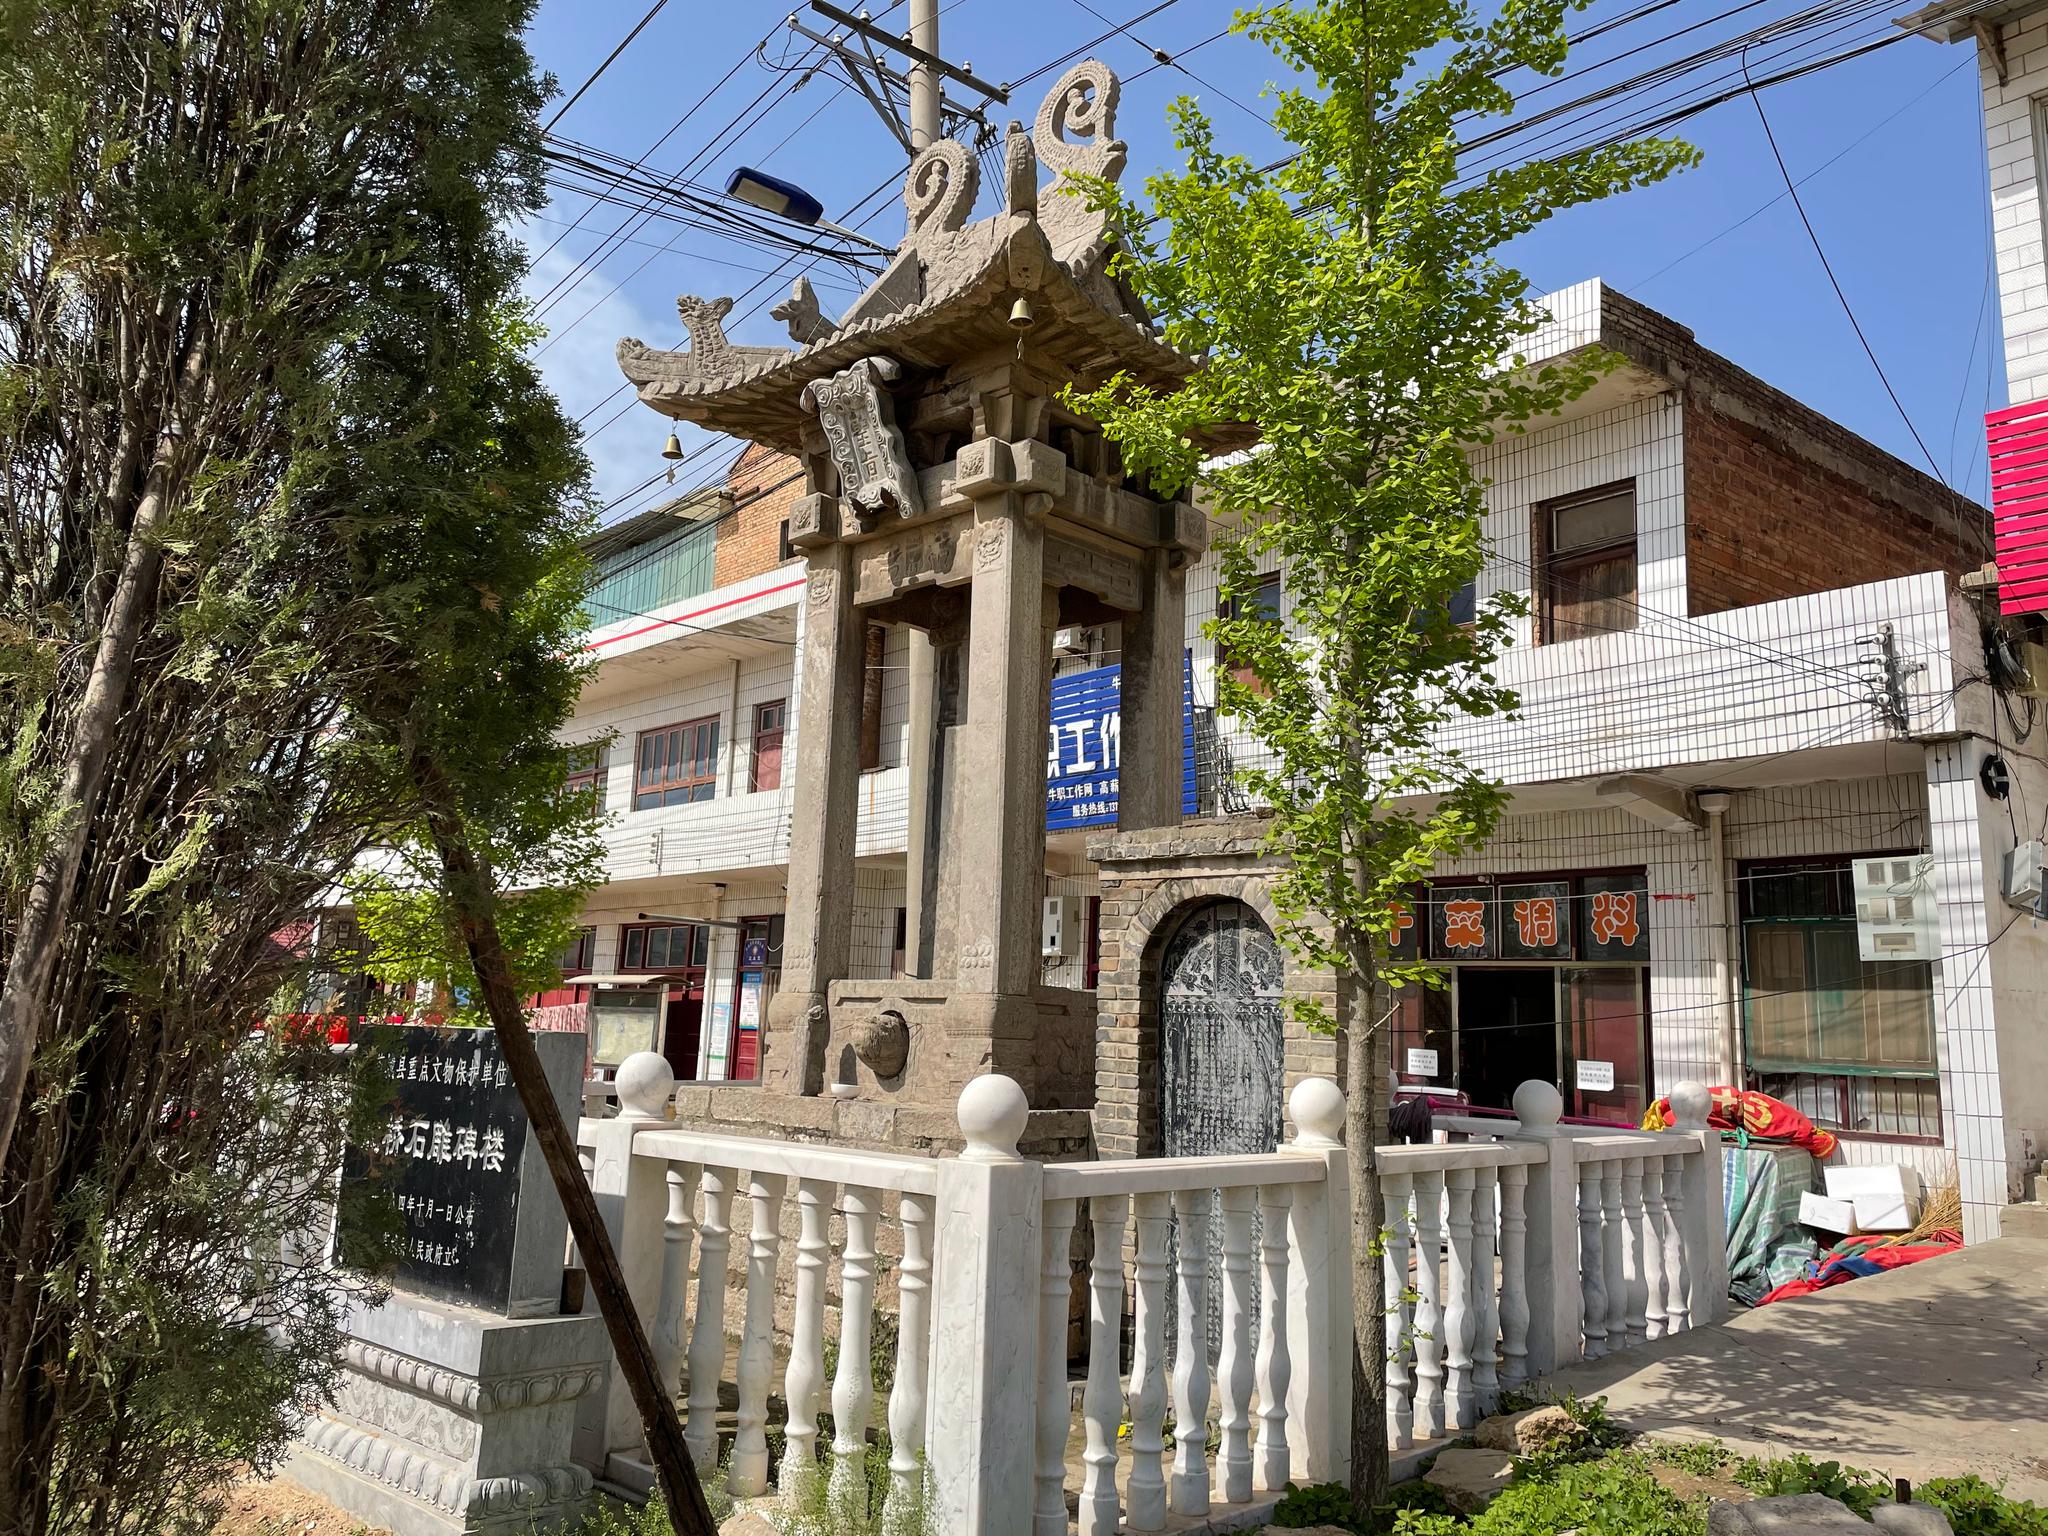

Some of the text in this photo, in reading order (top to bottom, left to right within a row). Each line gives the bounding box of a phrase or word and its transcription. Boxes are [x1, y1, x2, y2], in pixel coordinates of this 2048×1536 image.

[1047, 783, 1093, 802] 牛职工作网
[378, 1053, 507, 1089] 县重点文物保护单位
[371, 1188, 475, 1228] 四年十月一日公布
[383, 1231, 452, 1266] 人民政府立
